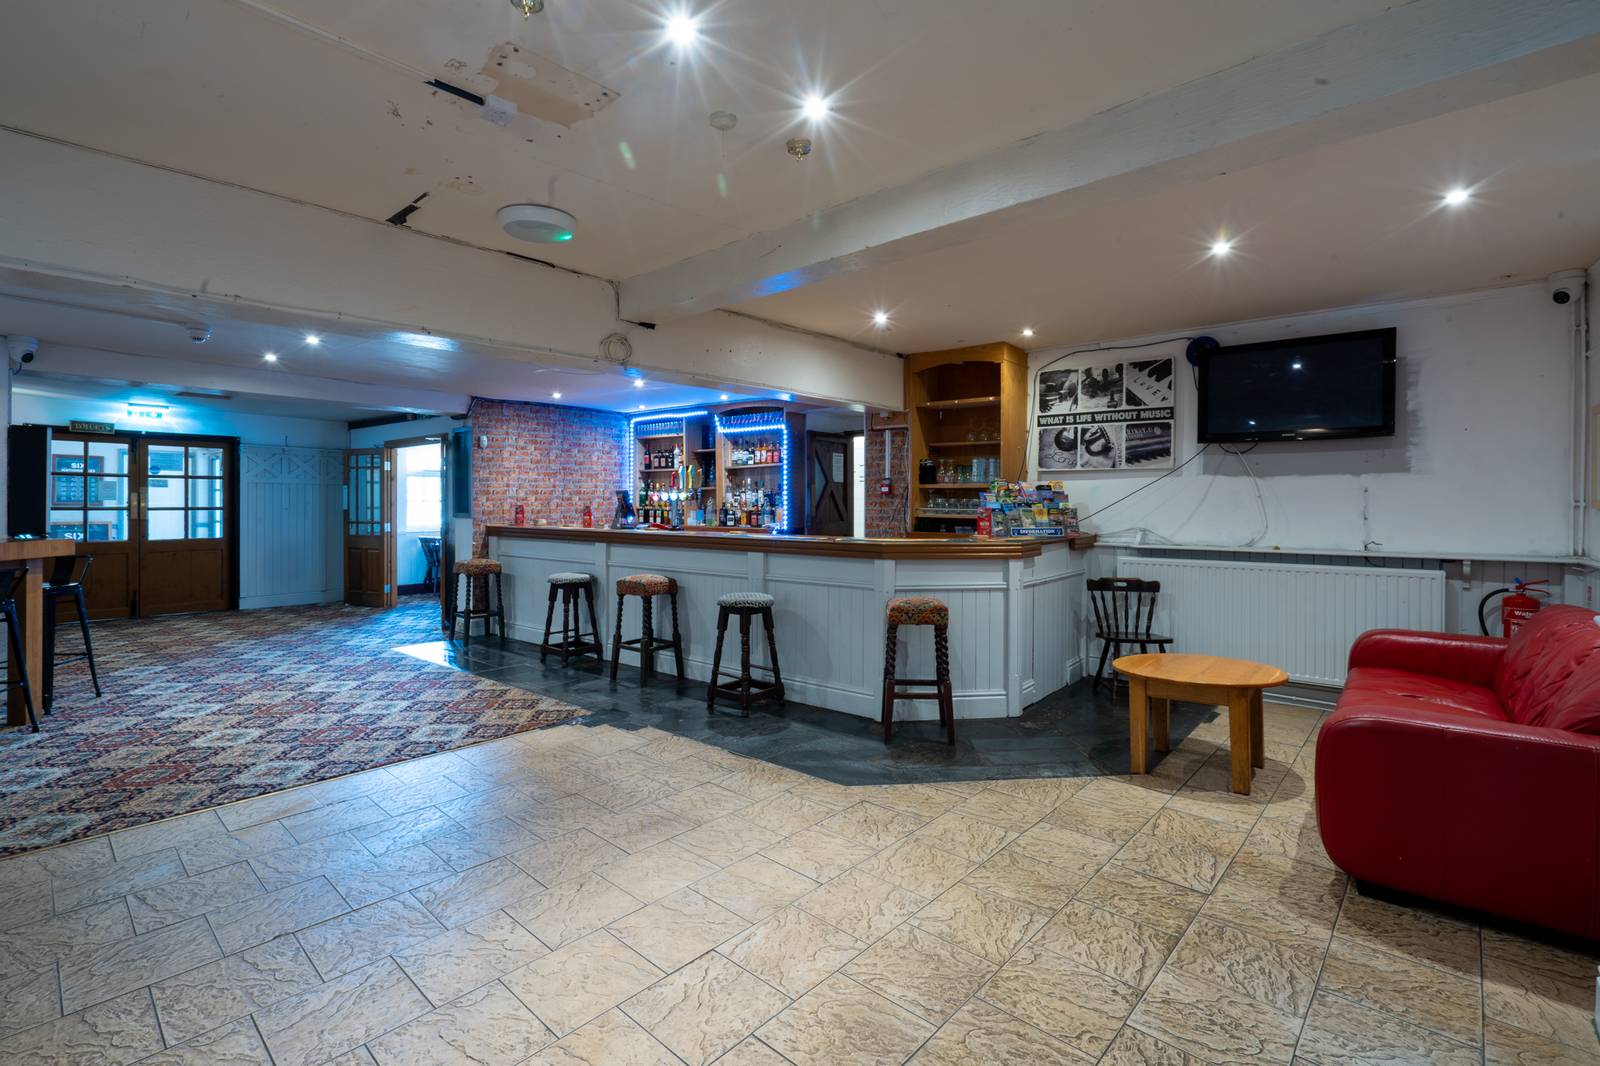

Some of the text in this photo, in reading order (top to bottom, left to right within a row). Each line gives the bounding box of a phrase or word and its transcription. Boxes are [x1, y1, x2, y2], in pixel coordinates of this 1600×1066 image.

[1039, 409, 1172, 425] WHAT IS LIFE WITHOUT MUSIC
